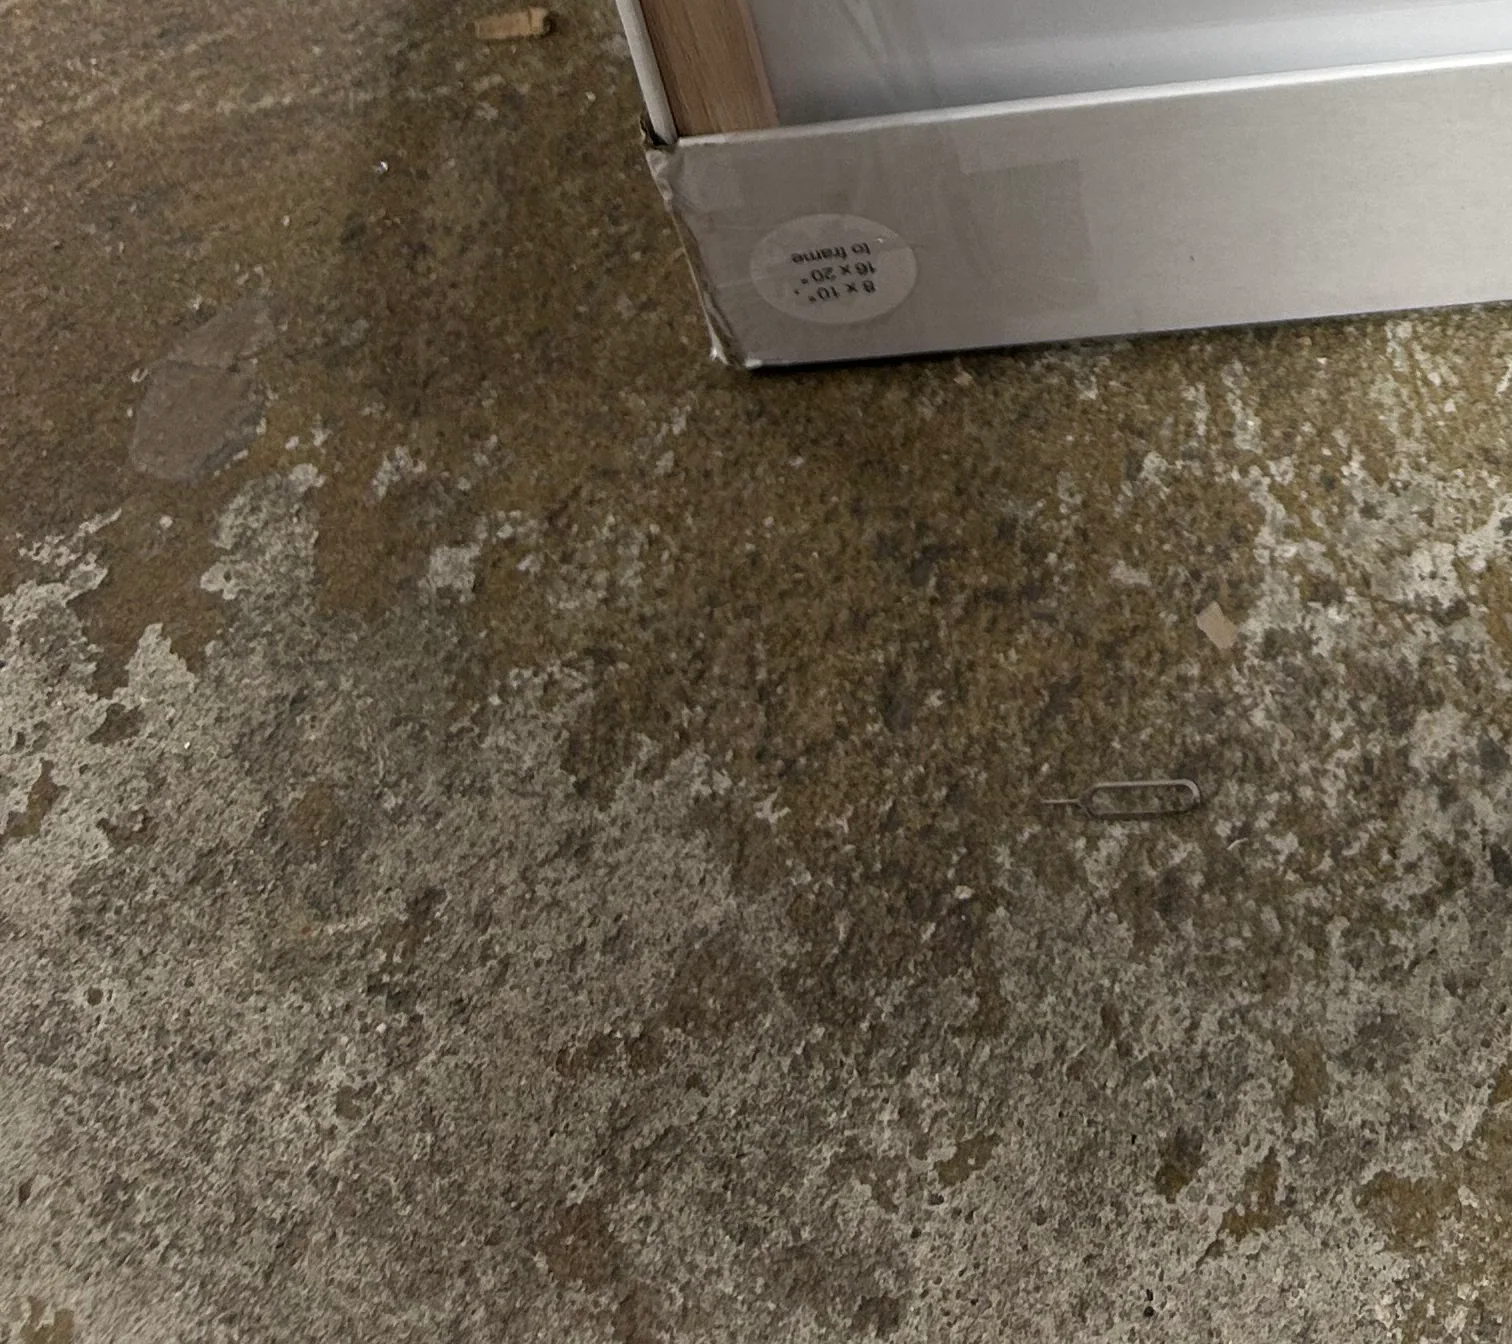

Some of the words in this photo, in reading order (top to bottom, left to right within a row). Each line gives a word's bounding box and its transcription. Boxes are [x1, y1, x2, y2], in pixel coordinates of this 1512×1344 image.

[790, 245, 848, 265] frame
[850, 242, 871, 256] to
[838, 264, 853, 275] x
[854, 260, 877, 277] 16
[862, 279, 877, 294] 8
